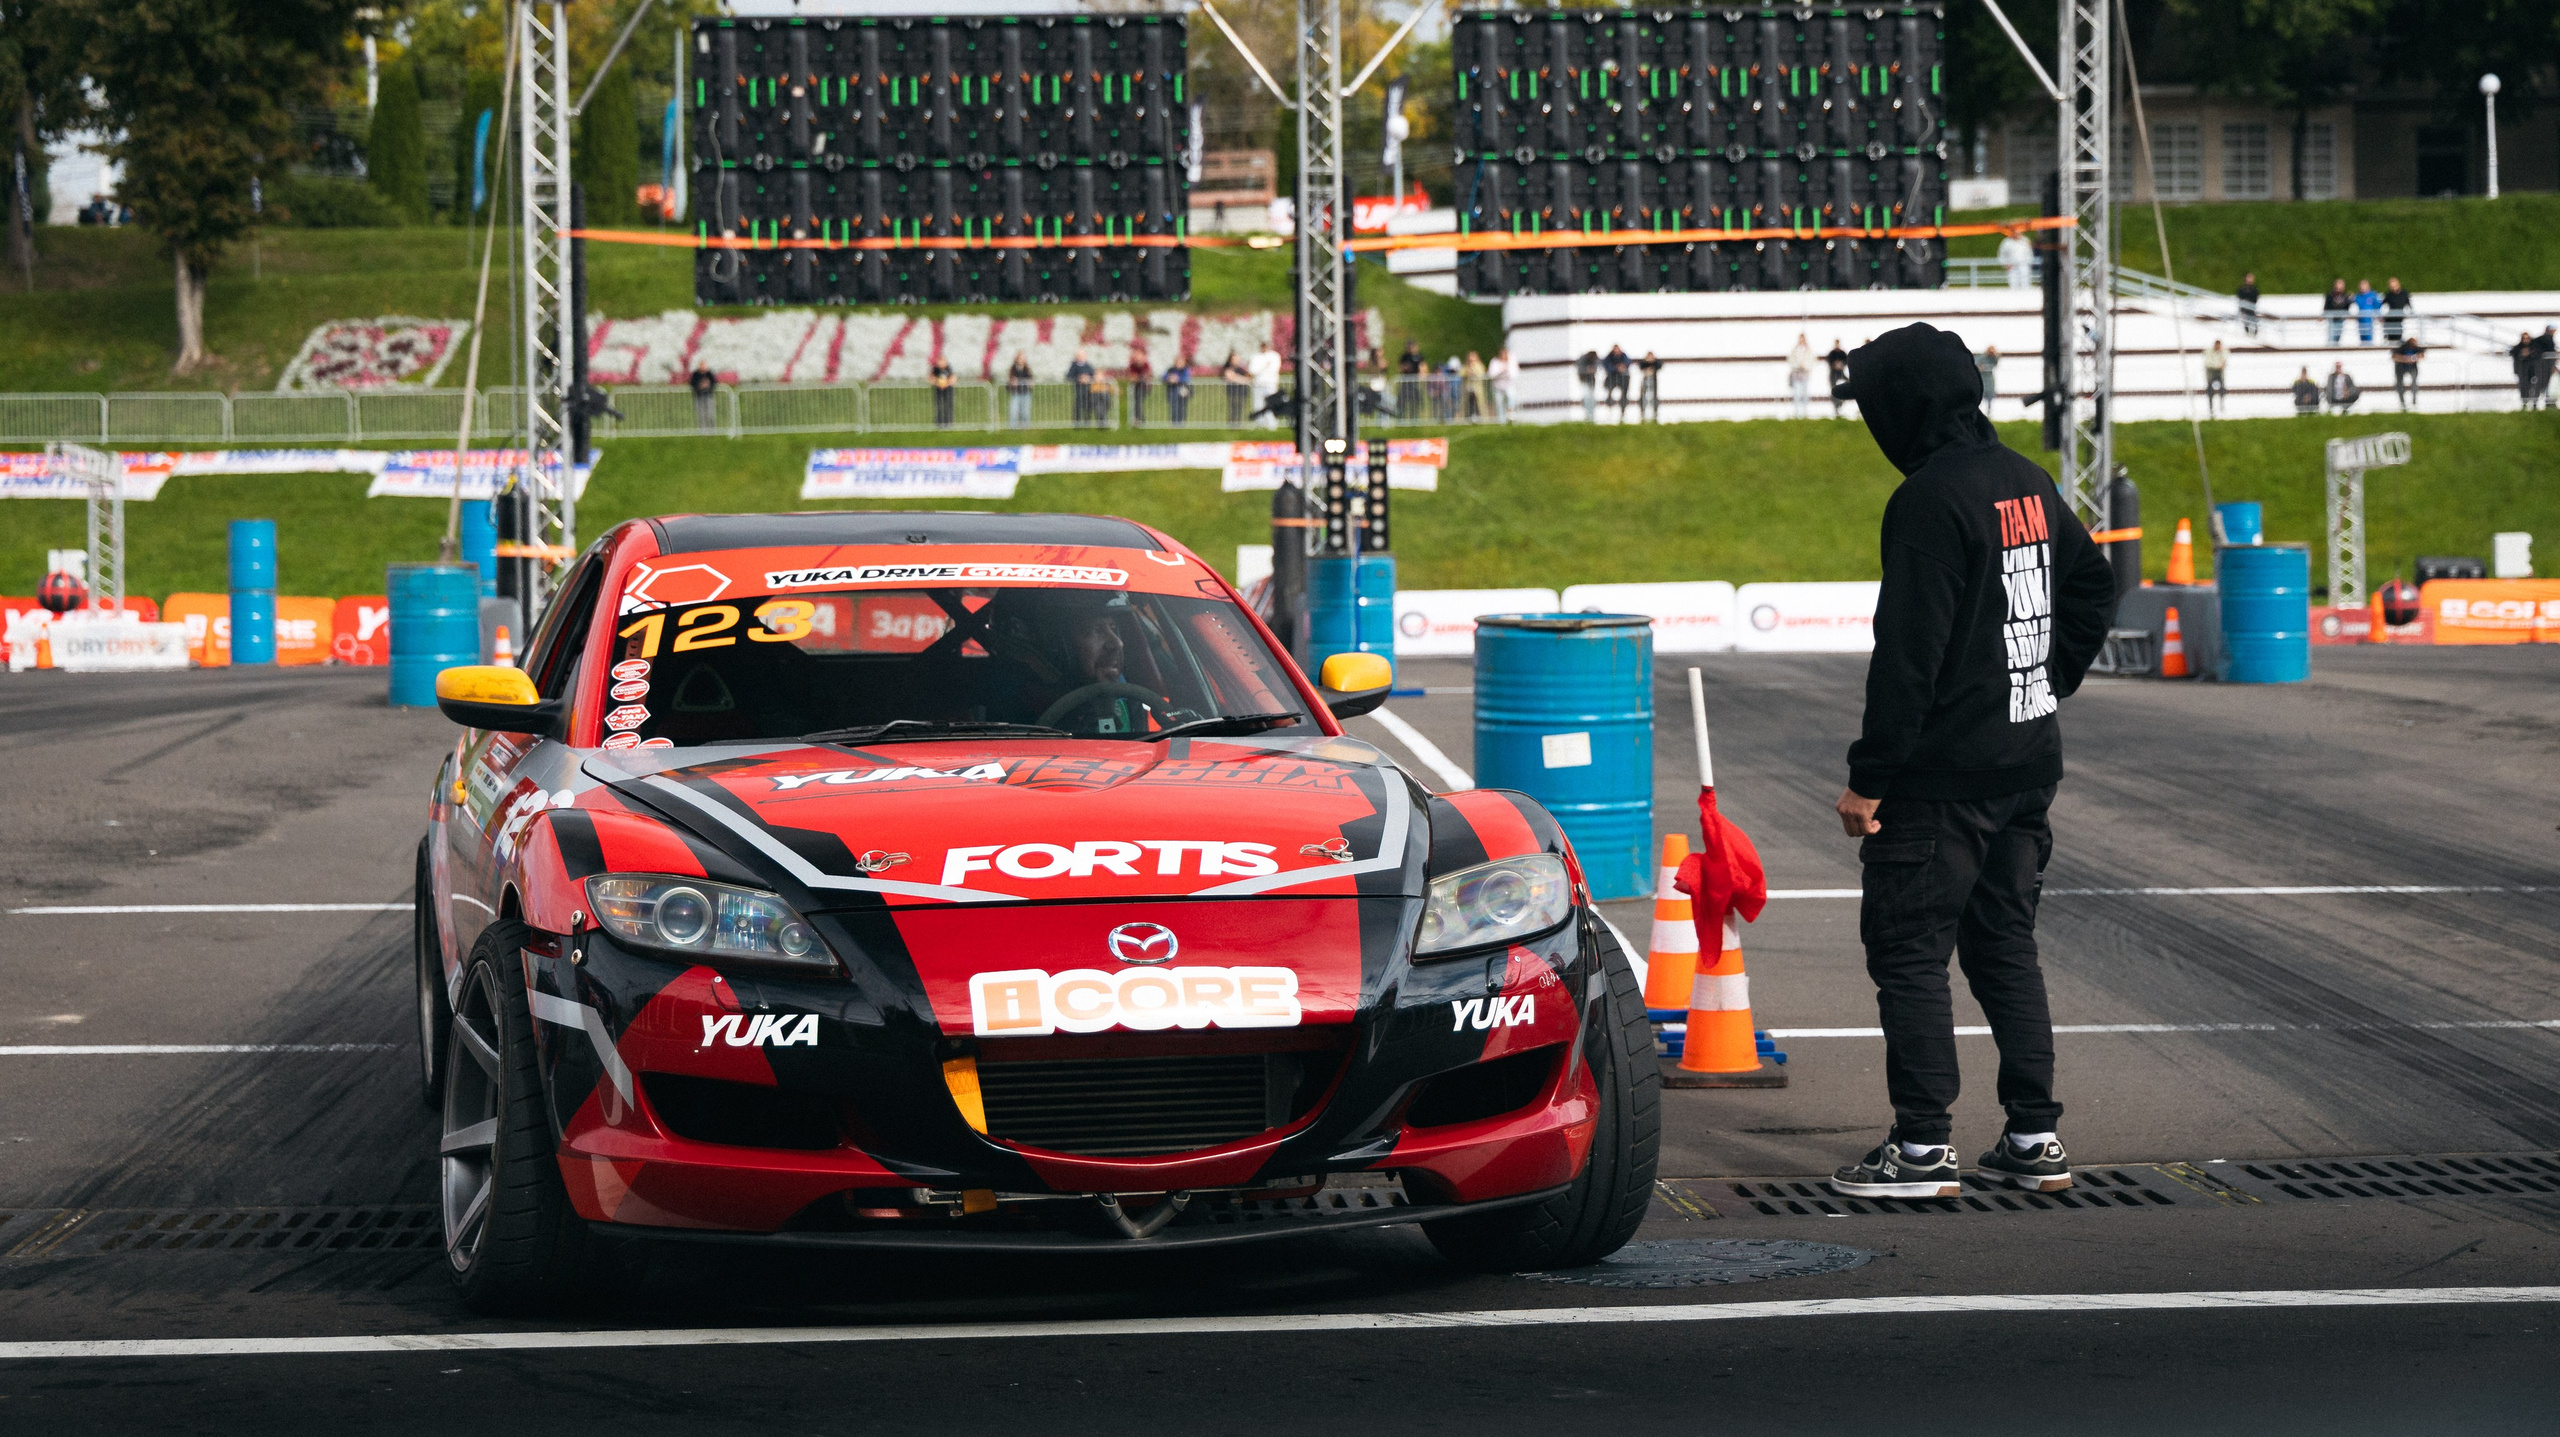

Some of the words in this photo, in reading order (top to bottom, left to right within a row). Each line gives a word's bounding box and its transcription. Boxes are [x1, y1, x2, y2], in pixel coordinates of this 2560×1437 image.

[1994, 494, 2049, 547] TEAM
[772, 570, 853, 585] YUKA
[859, 567, 958, 580] DRIVE
[967, 566, 1114, 582] GYMKHANA
[618, 600, 815, 659] 123
[772, 762, 1008, 791] YUKA
[941, 840, 1279, 886] FORTIS
[701, 1014, 820, 1047] YUKA
[1451, 994, 1535, 1032] YUKA
